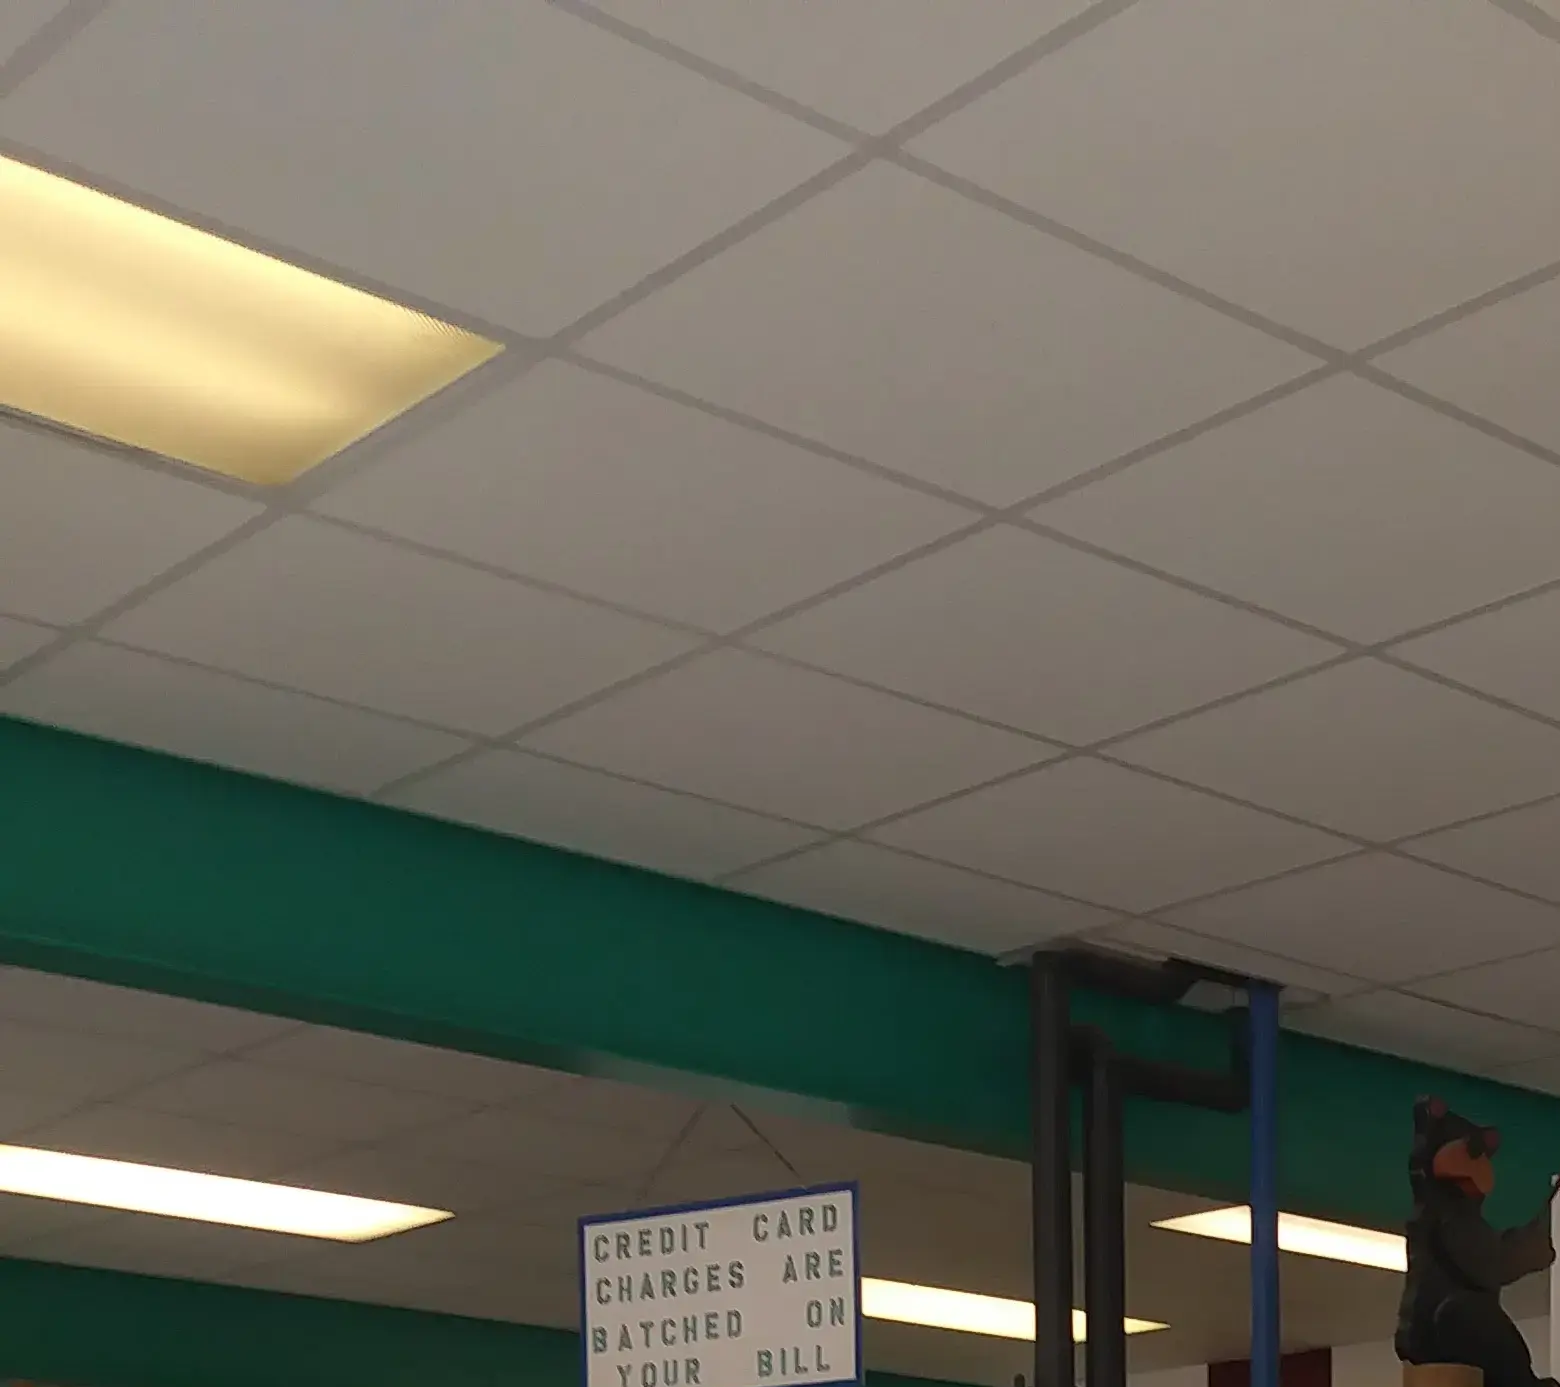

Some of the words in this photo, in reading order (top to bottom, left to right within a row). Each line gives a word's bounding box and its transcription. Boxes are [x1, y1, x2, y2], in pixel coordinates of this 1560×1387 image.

[594, 1222, 711, 1262] CREDIT
[752, 1203, 838, 1243] CARD
[596, 1260, 746, 1305] CHARGES
[782, 1248, 844, 1284] ARE
[591, 1308, 744, 1353] BATCHED
[806, 1297, 846, 1328] ON
[756, 1345, 831, 1378] BILL
